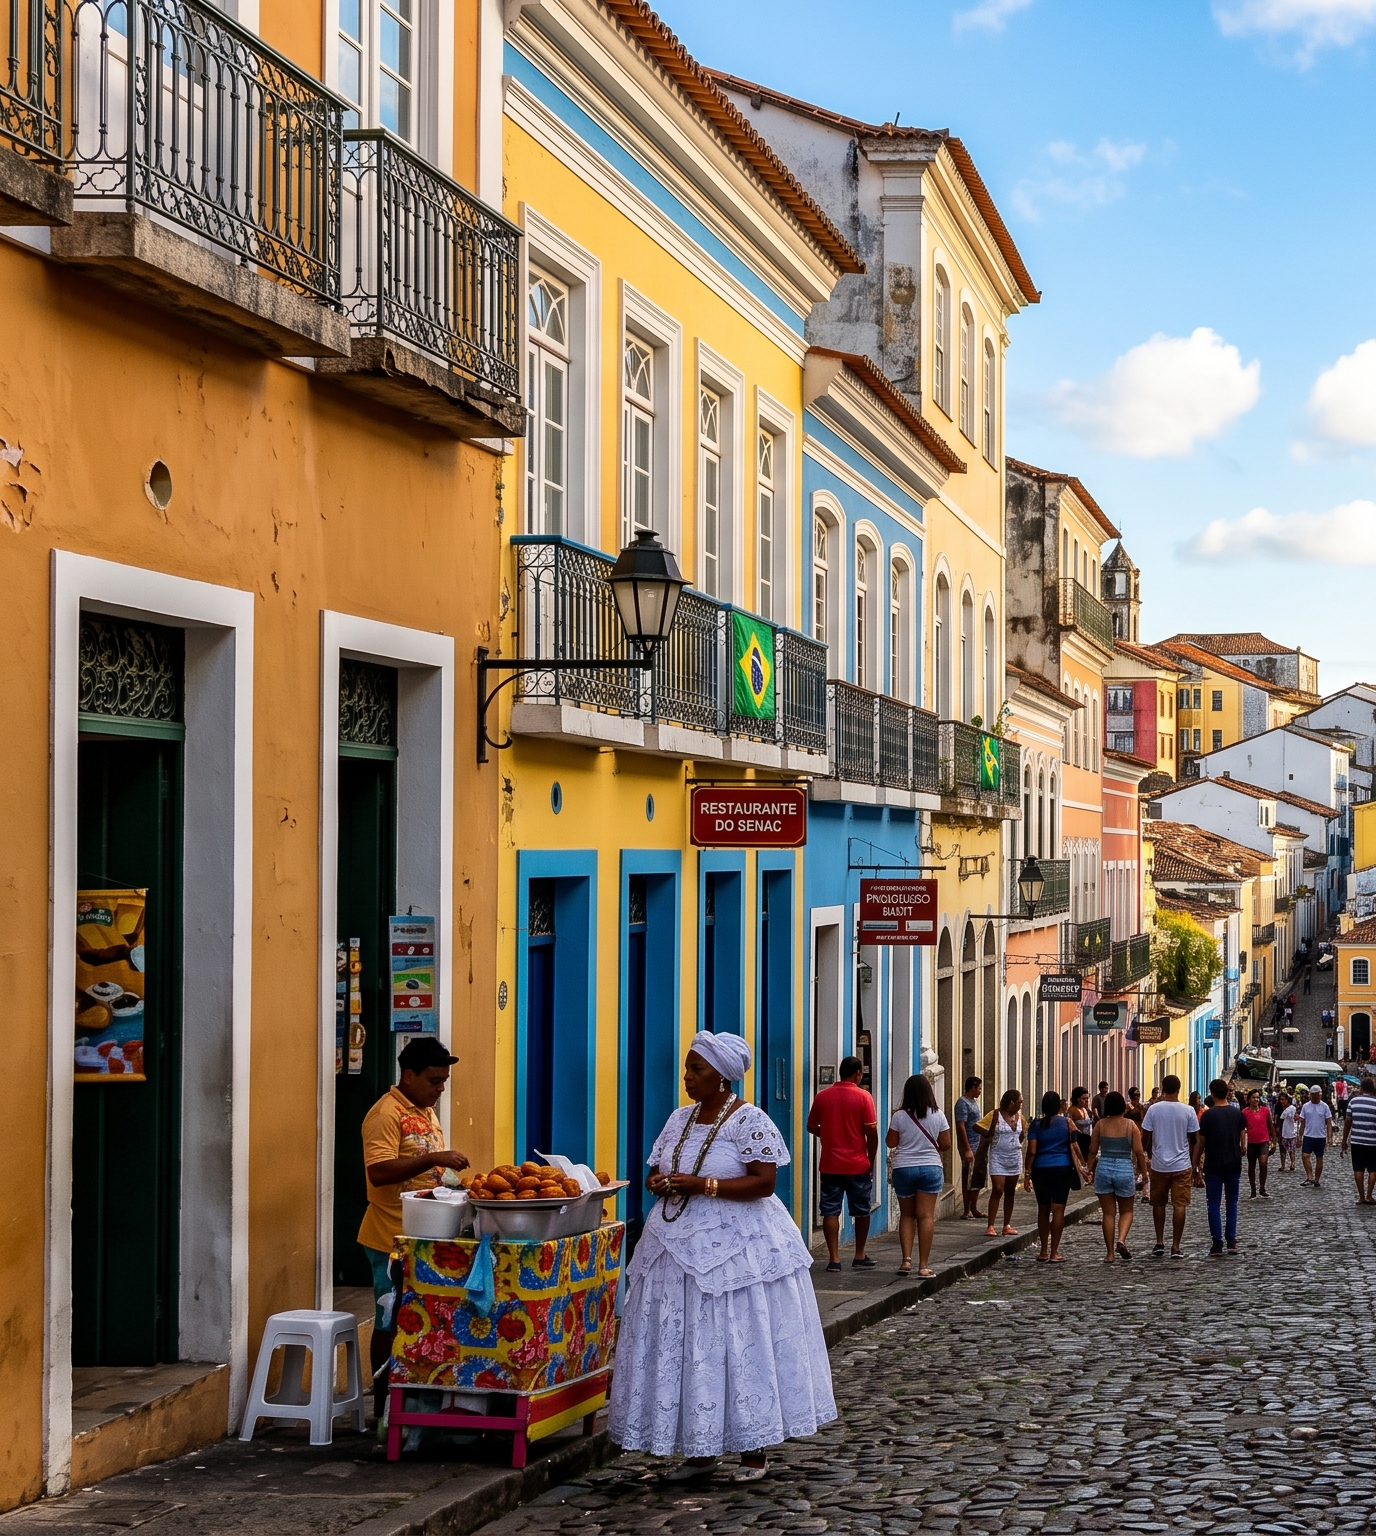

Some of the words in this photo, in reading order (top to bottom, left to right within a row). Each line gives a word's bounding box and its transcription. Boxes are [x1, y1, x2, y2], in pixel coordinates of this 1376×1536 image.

[700, 802, 797, 815] RESTAURANTE
[715, 820, 735, 832] DO
[738, 820, 782, 832] SENAC
